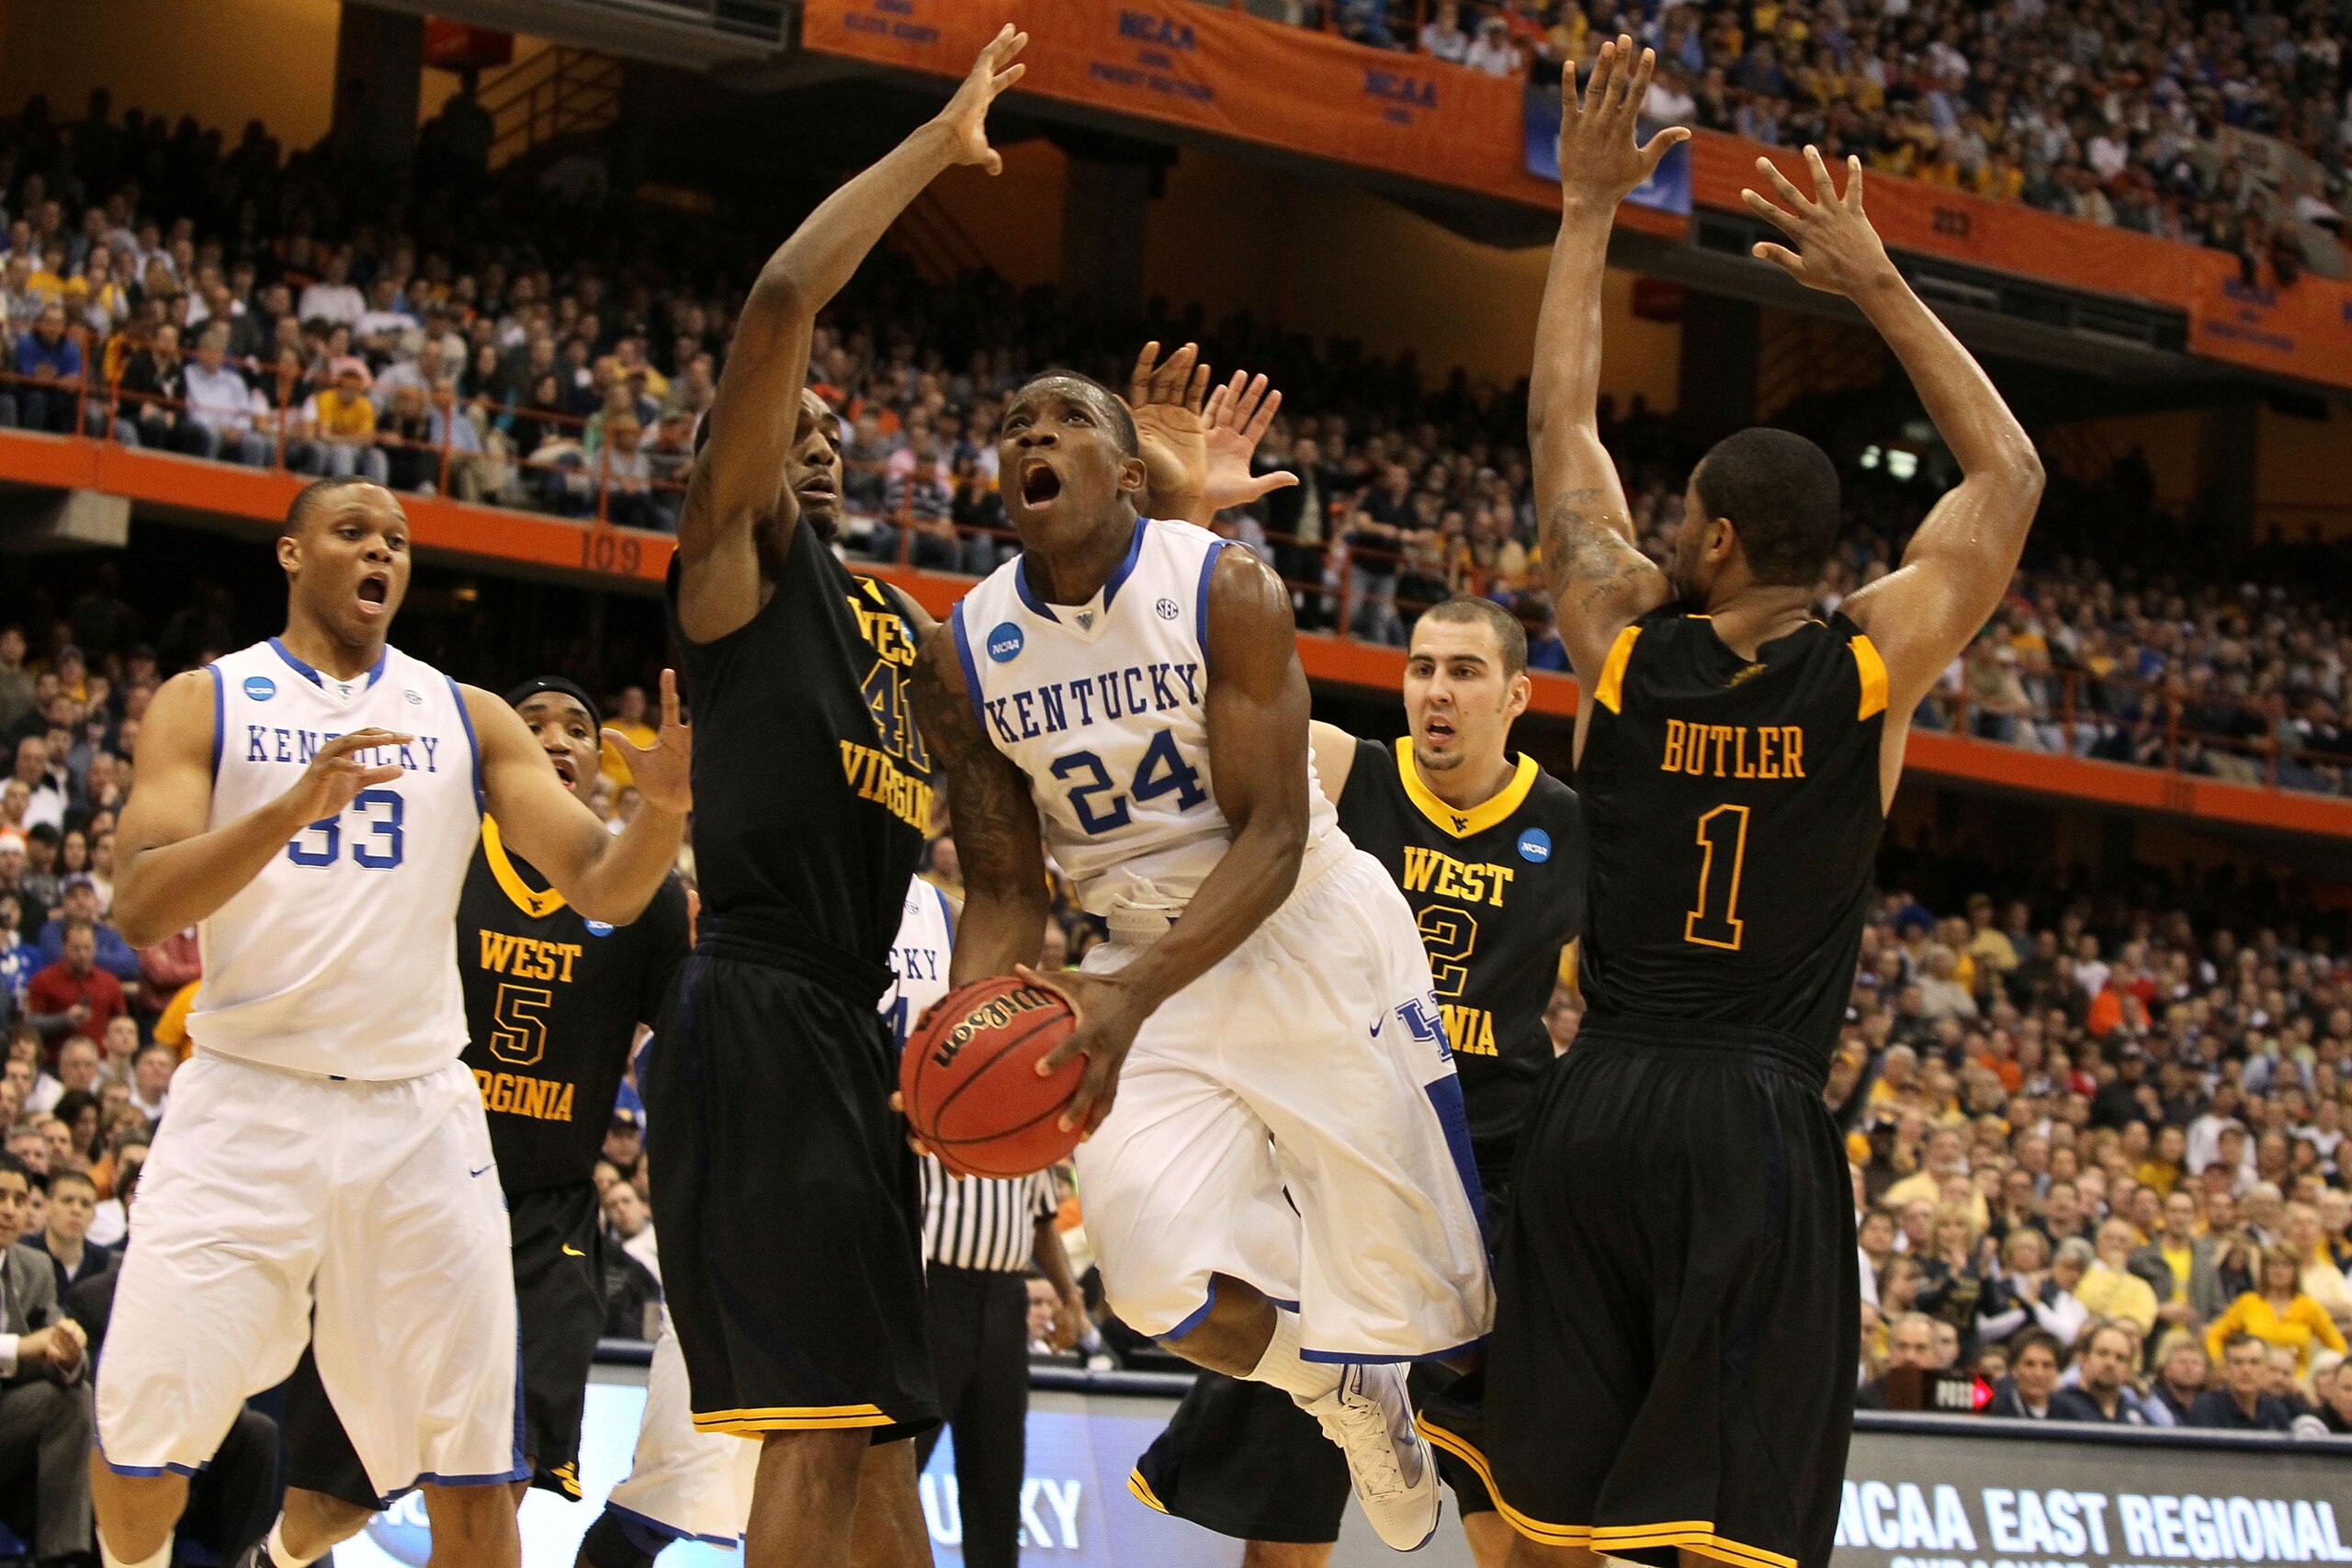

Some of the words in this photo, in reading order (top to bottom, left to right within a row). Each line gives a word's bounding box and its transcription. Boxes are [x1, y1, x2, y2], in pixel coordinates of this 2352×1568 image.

[582, 531, 641, 571] 109
[860, 659, 932, 774] 41
[985, 663, 1199, 743] KENTUCKY
[1050, 728, 1207, 835] 24
[1660, 718, 1806, 779] BUTLER
[287, 789, 405, 872] 33
[1403, 845, 1514, 908] WEST
[1683, 803, 1750, 951] 1
[479, 929, 582, 983] WEST
[1416, 904, 1478, 998] 2
[489, 982, 552, 1066] 5
[471, 1068, 575, 1122] RGINIA
[1834, 1479, 1978, 1551] NCAA
[1981, 1487, 2111, 1557] EAST
[2116, 1493, 2352, 1562] REGIONAL
